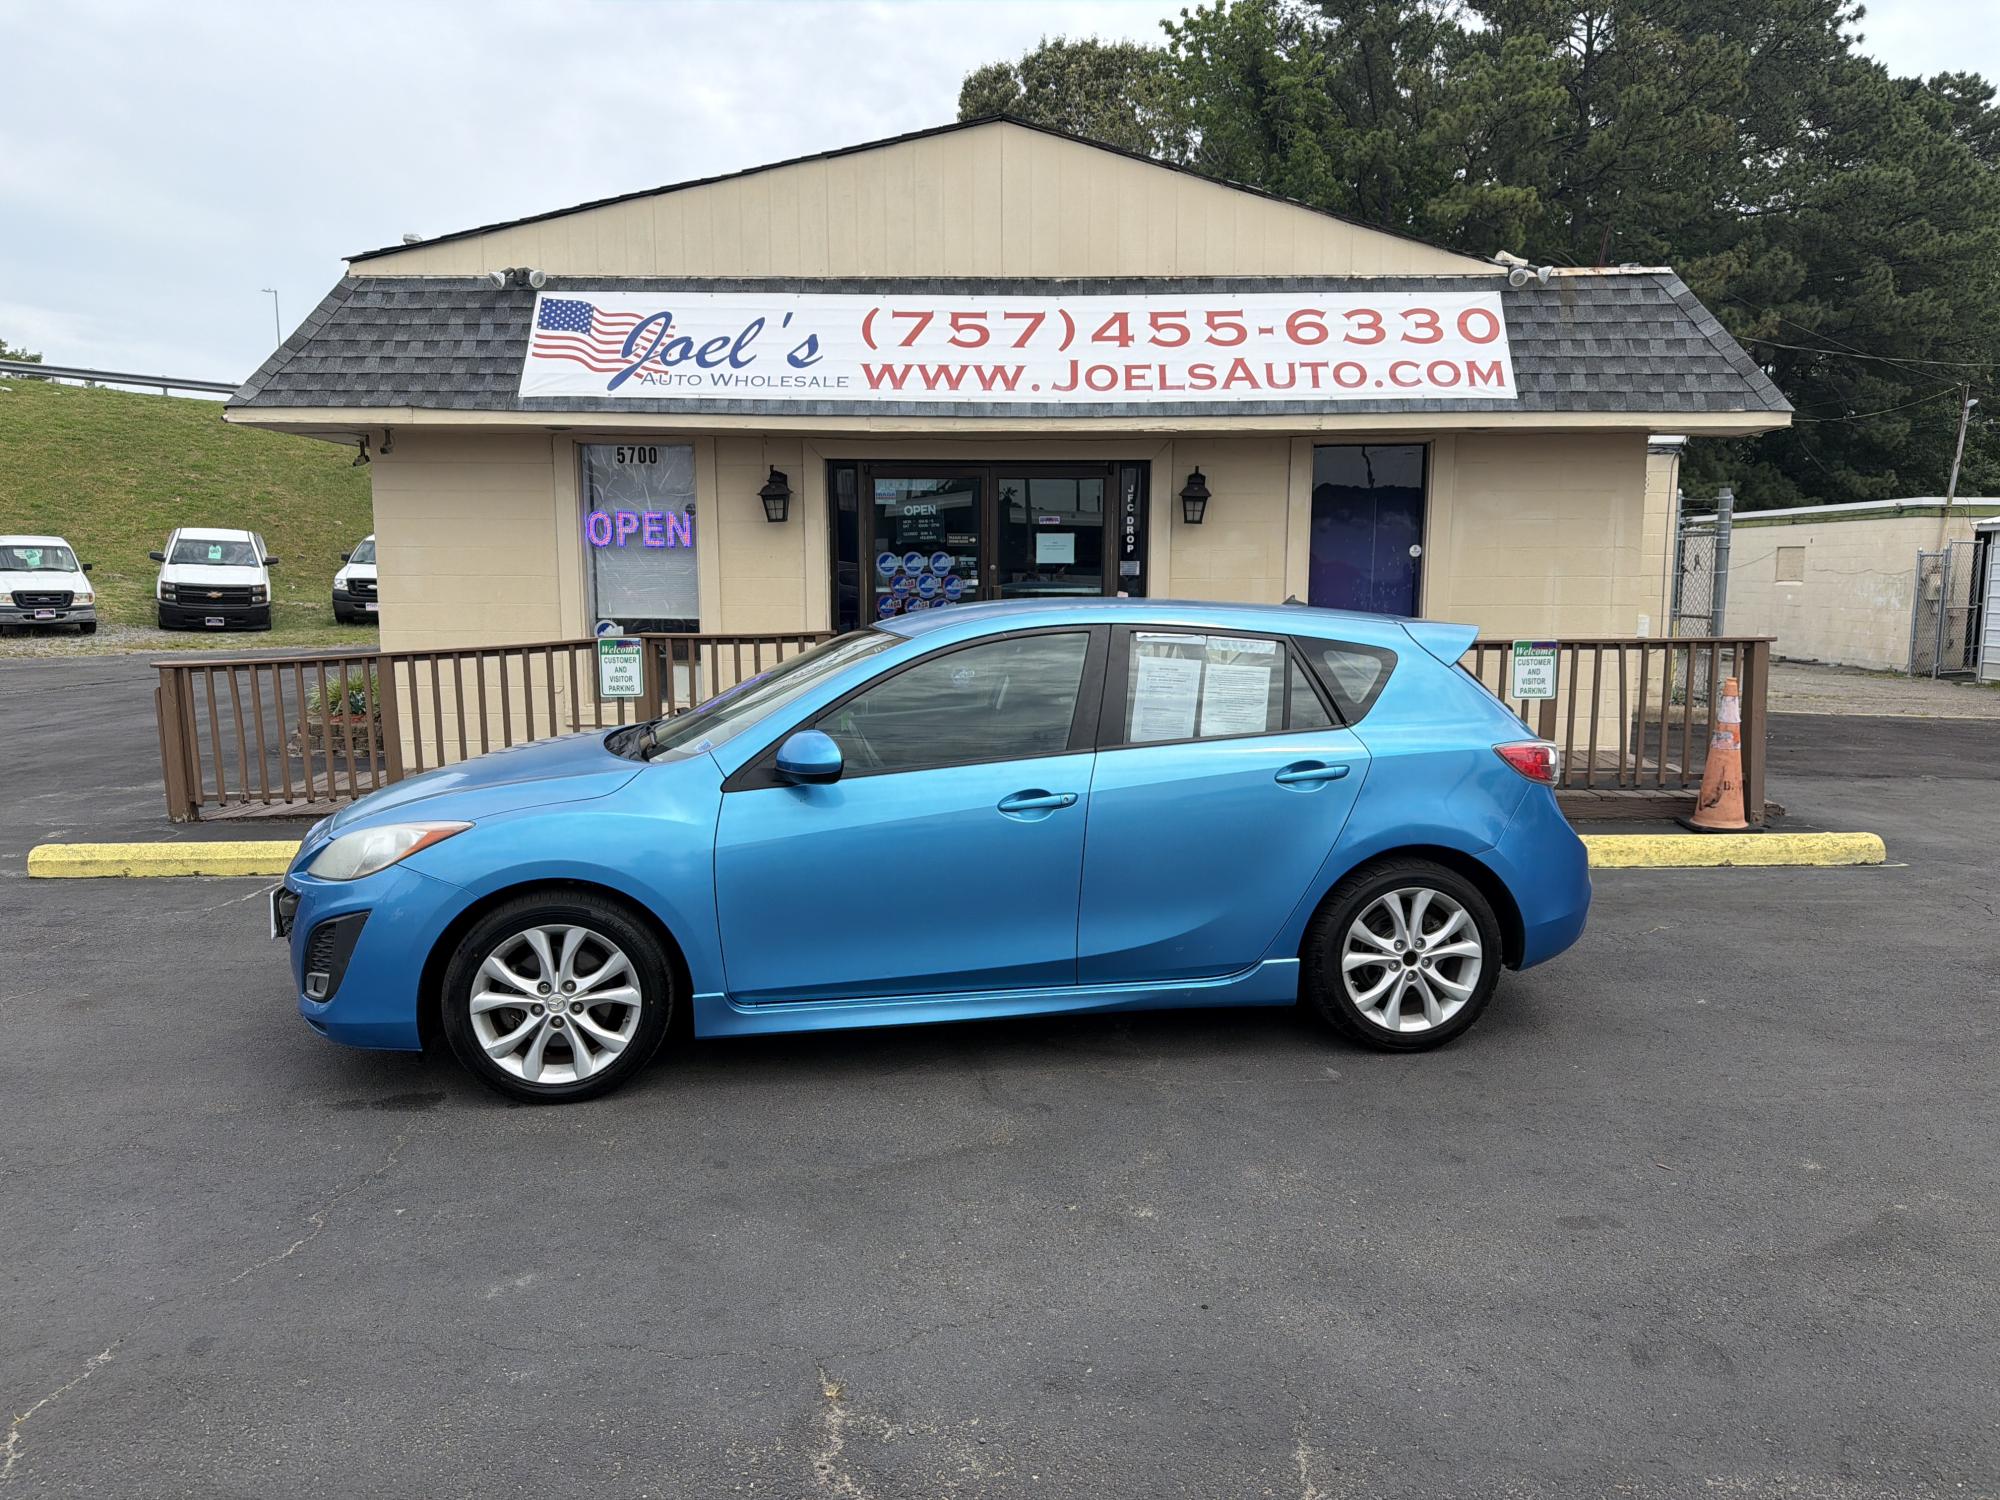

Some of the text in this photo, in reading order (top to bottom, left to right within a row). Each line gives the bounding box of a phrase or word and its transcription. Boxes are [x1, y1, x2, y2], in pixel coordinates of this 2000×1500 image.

[861, 307, 1501, 351] (757)455-6330
[607, 311, 823, 391] Joel's
[640, 372, 849, 388] AUTO WHOLESALE
[616, 446, 658, 464] 5700
[904, 505, 936, 516] OPEN
[586, 510, 693, 549] OPEN
[1126, 516, 1135, 553] DROP
[601, 645, 639, 654] Welcome
[1515, 647, 1554, 656] Welcome
[603, 656, 637, 664] CUSTOMER
[1517, 658, 1552, 666] CUSTOMER
[614, 666, 628, 674] AND
[609, 675, 633, 683] VISITOR
[1521, 677, 1546, 685] VISITOR
[1519, 687, 1547, 695] PARKING
